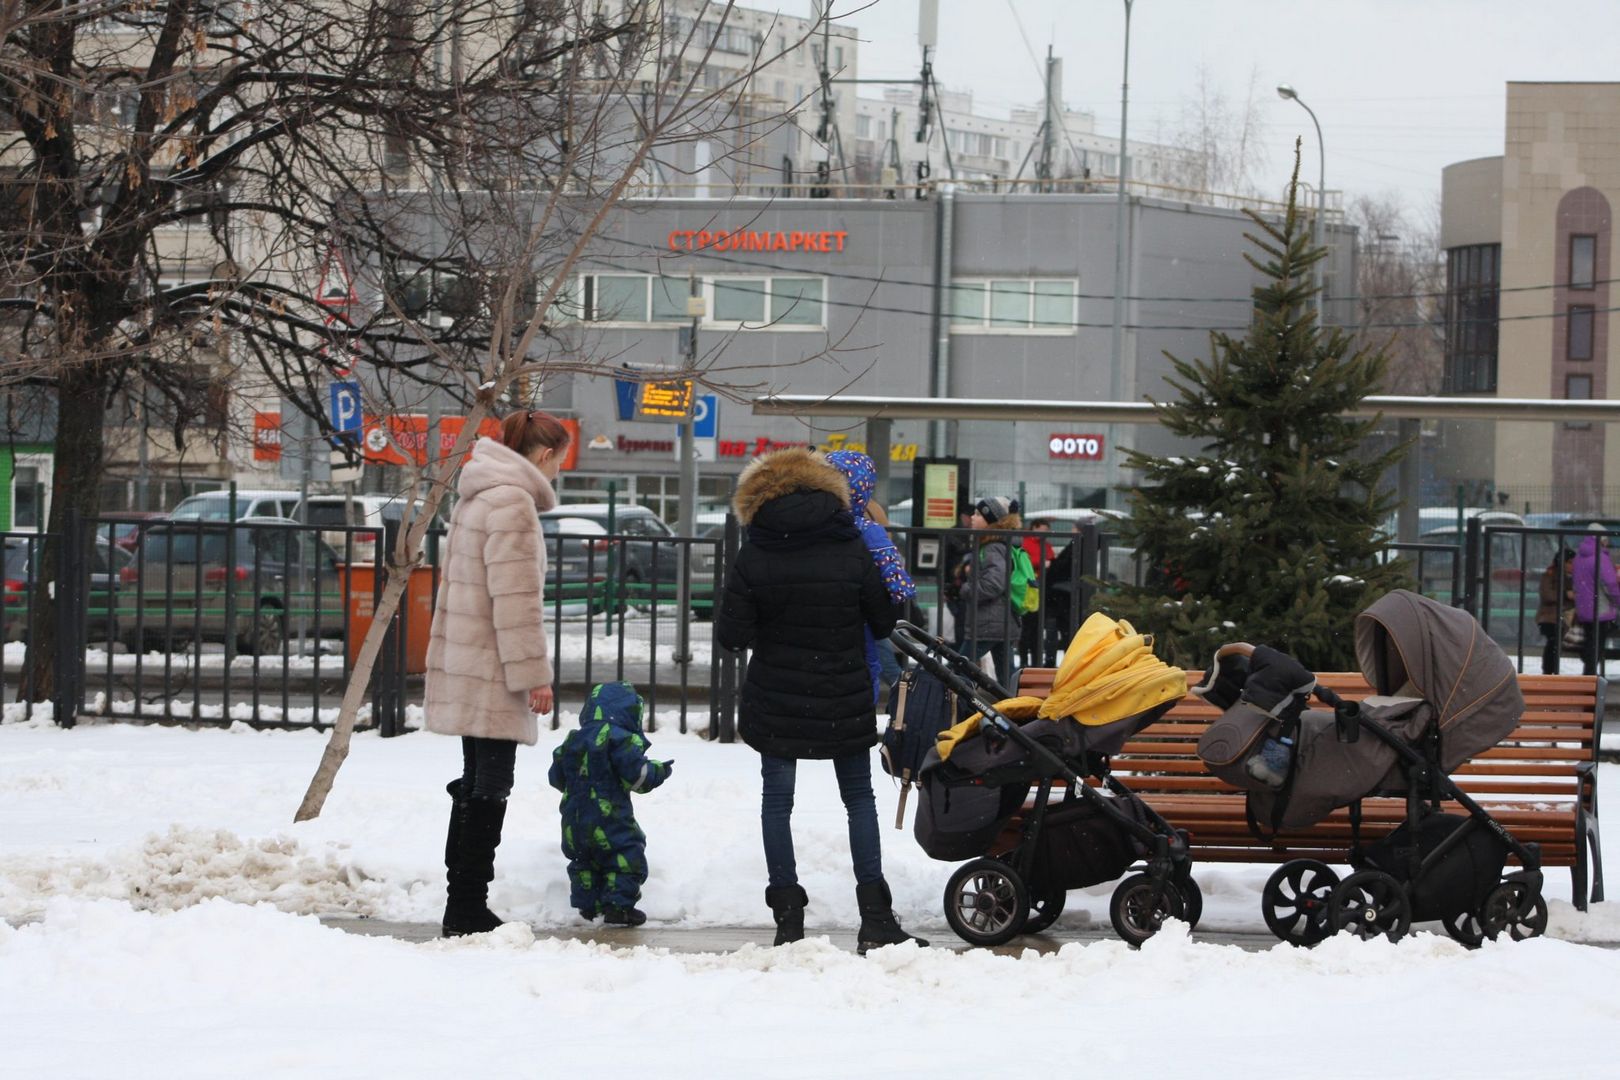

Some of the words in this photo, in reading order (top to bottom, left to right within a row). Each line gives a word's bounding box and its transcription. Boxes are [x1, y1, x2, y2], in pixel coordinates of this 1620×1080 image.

[668, 228, 848, 252] СТРОЙМАРКЕТ
[337, 389, 356, 433] P
[1050, 438, 1099, 455] ФОТО
